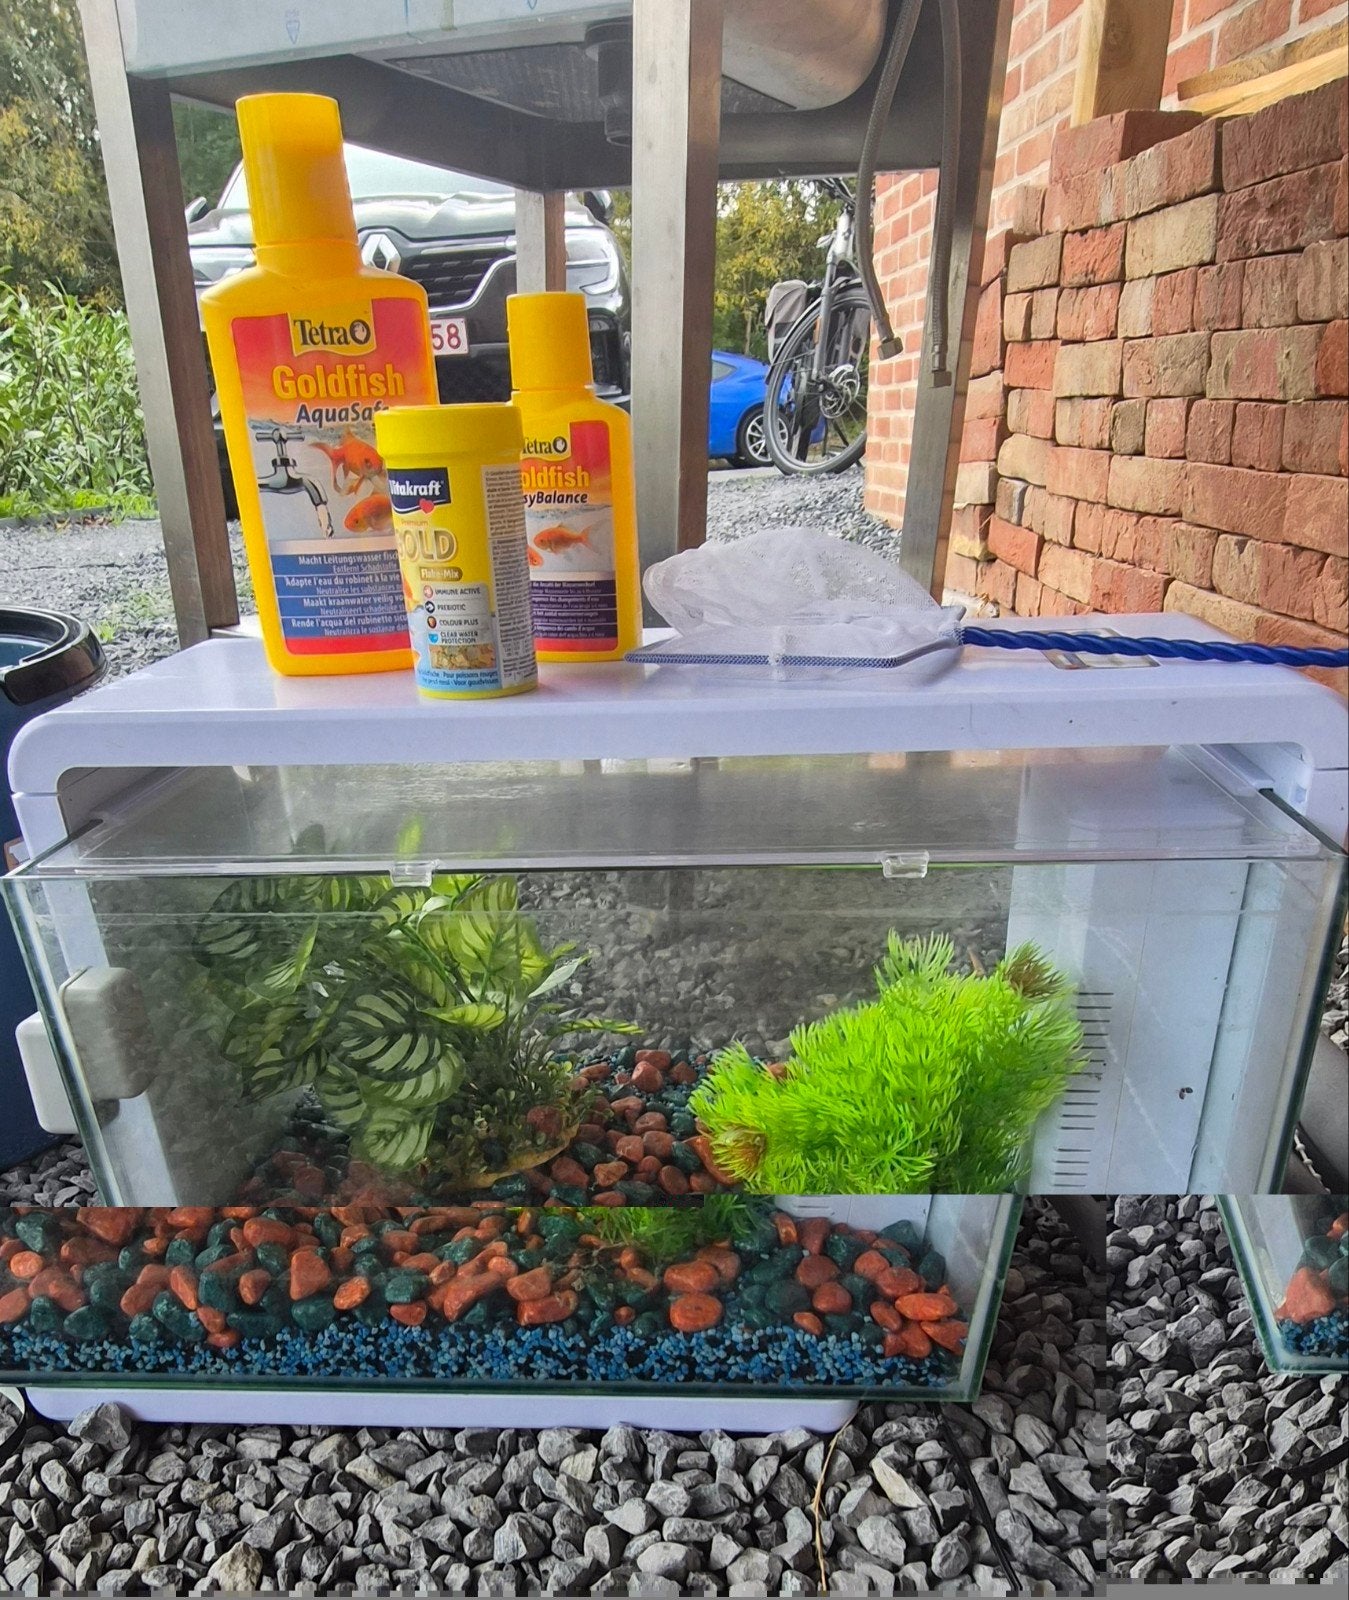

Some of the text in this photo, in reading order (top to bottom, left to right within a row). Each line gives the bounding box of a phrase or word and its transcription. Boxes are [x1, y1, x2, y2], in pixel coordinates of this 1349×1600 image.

[430, 323, 461, 350] 58
[272, 364, 405, 399] Goldfish
[296, 400, 389, 428] AquaSaf
[522, 465, 590, 489] oldfish
[523, 490, 588, 508] syBalance
[298, 556, 322, 565] Macht
[323, 554, 381, 565] Leitungswasser
[285, 576, 312, 588] Adapte
[334, 575, 344, 585] du
[345, 574, 374, 584] robinet
[380, 573, 388, 582] la
[460, 587, 481, 595] ACTIVE
[303, 598, 327, 607] Maakt
[329, 597, 372, 606] kraanwater
[291, 618, 314, 628] Rende
[344, 617, 356, 626] del
[358, 615, 392, 625] rubinetto
[464, 618, 479, 626] PLUS
